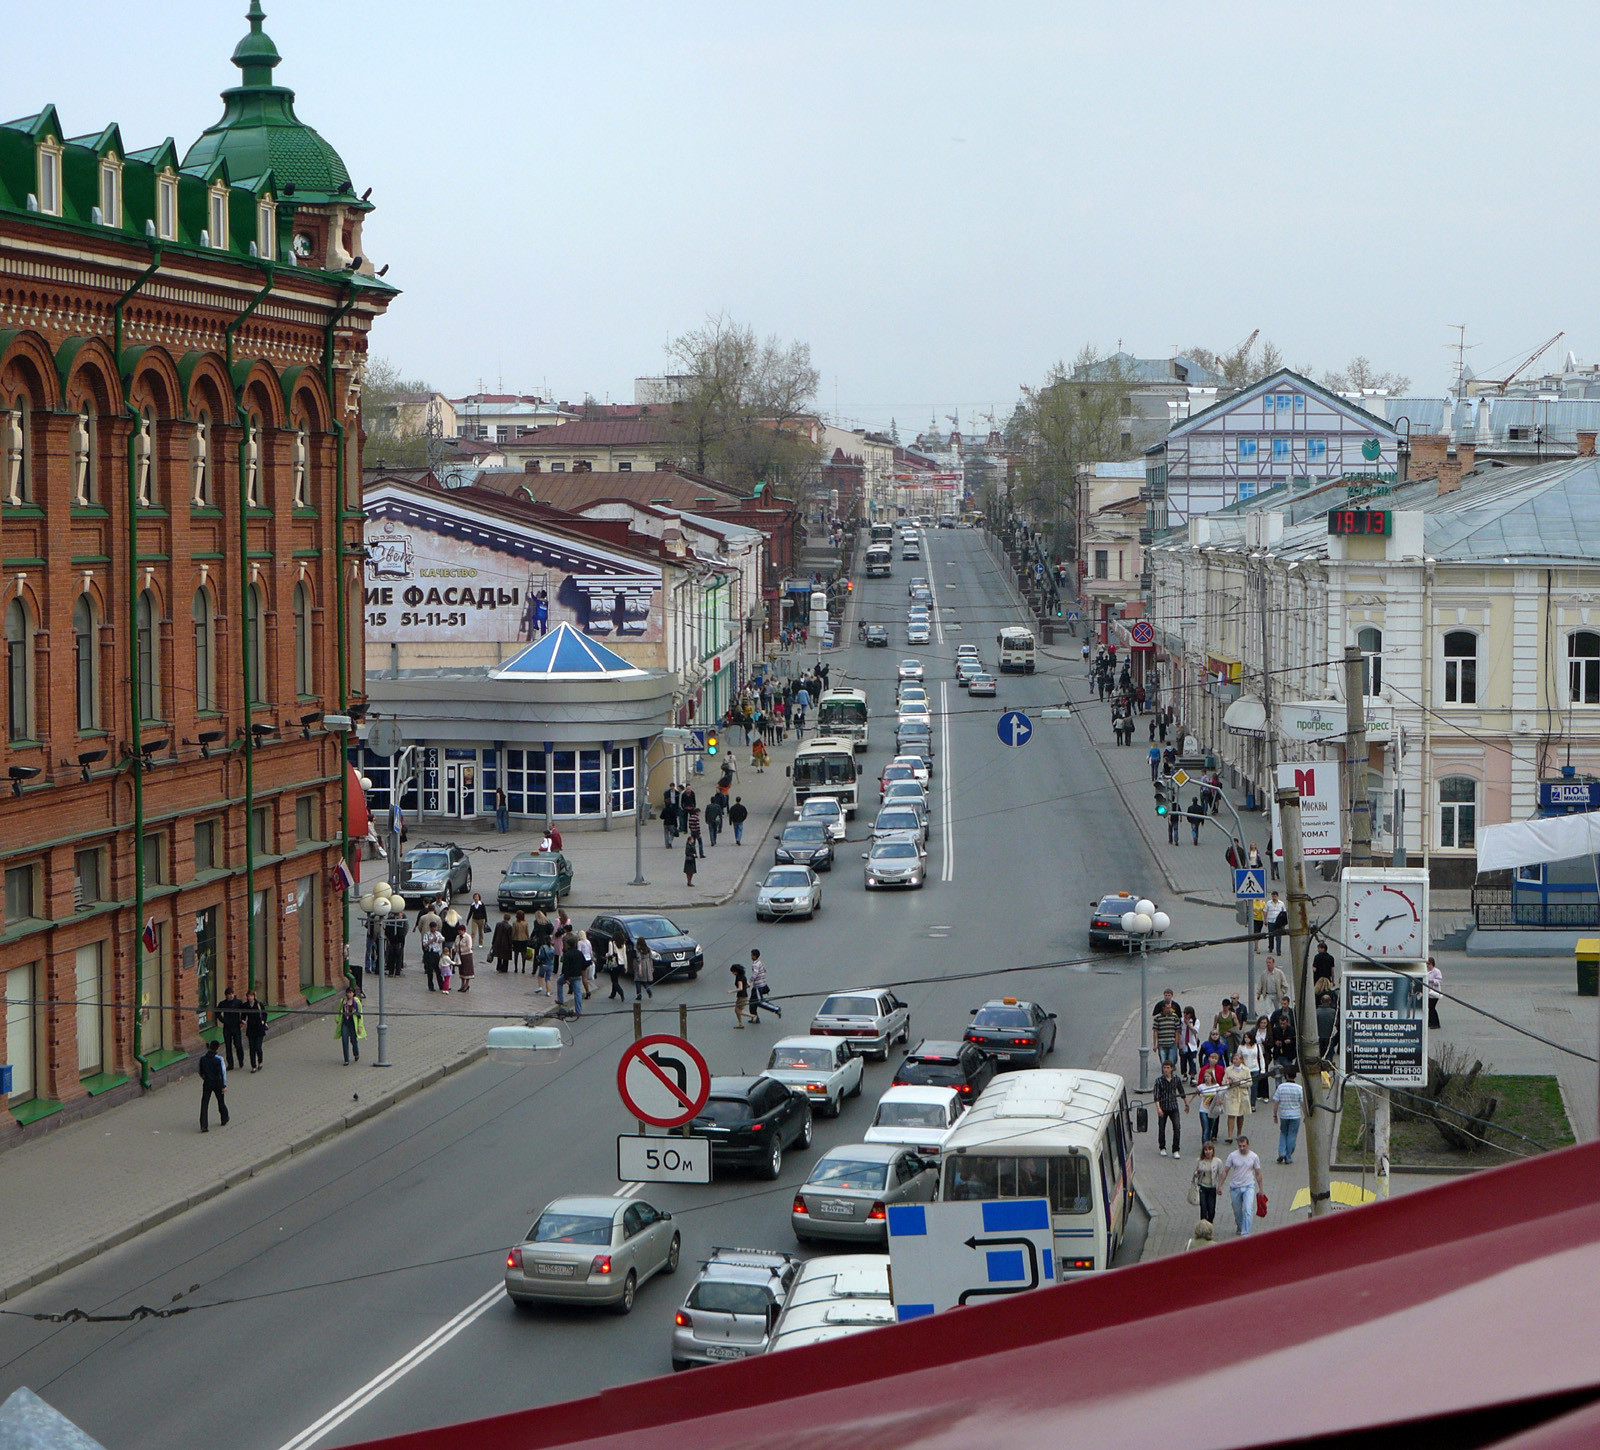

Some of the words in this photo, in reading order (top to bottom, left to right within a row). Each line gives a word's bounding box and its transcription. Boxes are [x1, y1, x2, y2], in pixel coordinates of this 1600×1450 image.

[419, 568, 478, 578] КАЧЕСТВО
[365, 587, 394, 606] ИЕ
[402, 585, 519, 610] ФАСАДЫ
[365, 612, 387, 627] -15
[401, 612, 467, 627] 51-11-51
[1297, 720, 1334, 732] прогресс
[1365, 722, 1390, 732] гресс
[1302, 800, 1328, 812] Москвы
[1350, 980, 1394, 992] ЧЕРНОЕ
[1352, 995, 1389, 1006] БЕЛОЕ
[1354, 1021, 1382, 1031] Пошив
[1384, 1023, 1417, 1032] одежды
[1354, 1044, 1378, 1053] Пошив
